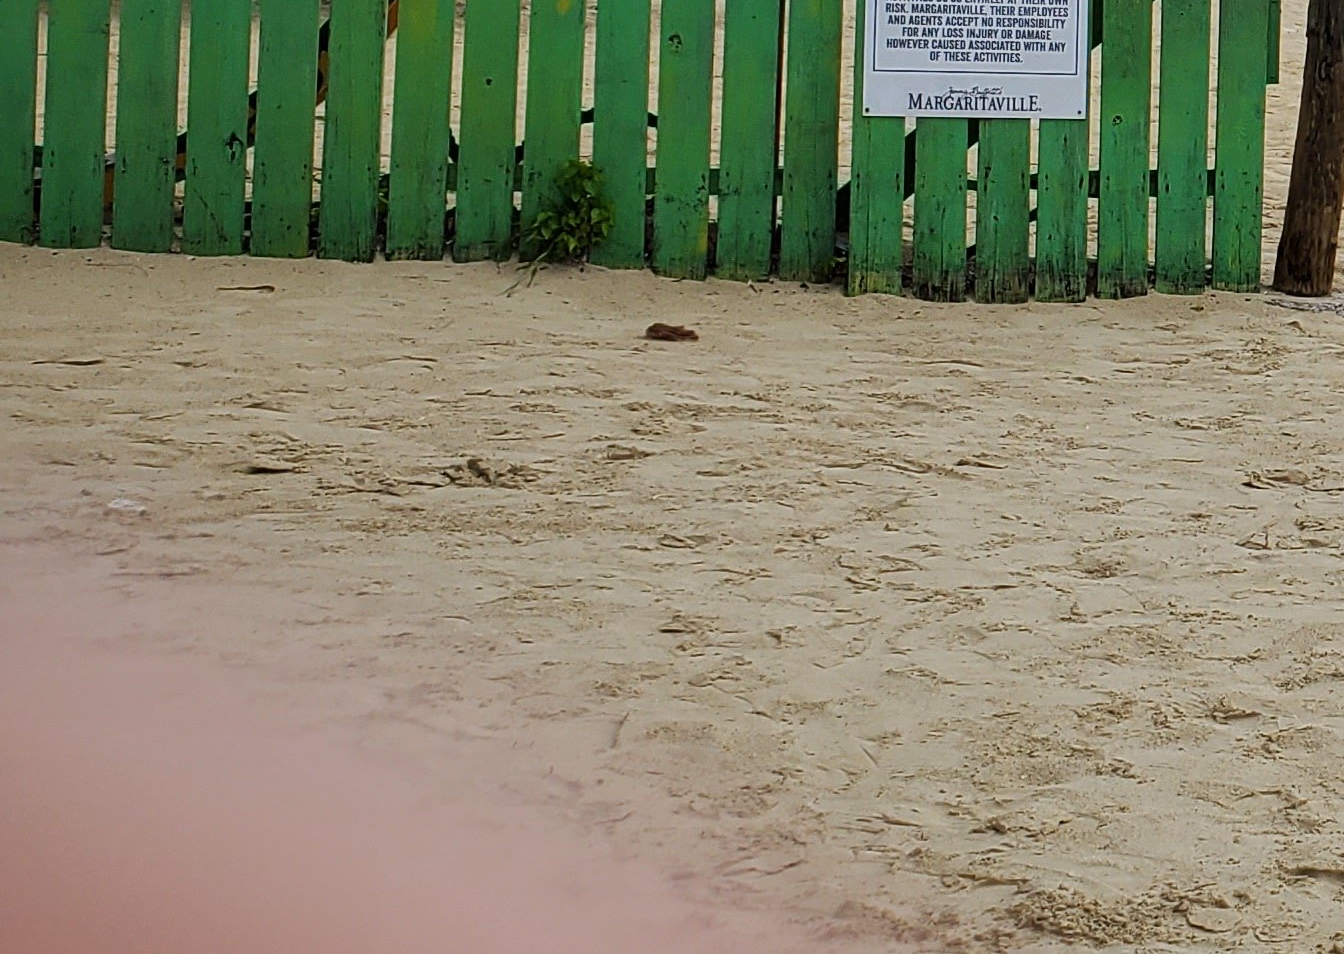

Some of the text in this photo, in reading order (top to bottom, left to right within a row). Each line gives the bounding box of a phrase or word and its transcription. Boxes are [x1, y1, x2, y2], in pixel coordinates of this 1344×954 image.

[886, 3, 908, 13] RISK.
[990, 6, 1015, 16] THEIR
[1018, 7, 1068, 17] EMPLOYEES
[888, 15, 1065, 29] AND AGENTS ACCEPT NO RESPONSIBILITY
[902, 27, 1051, 40] FOR ANY LOSS INJURY OR DAMAGE
[887, 39, 1066, 52] HOWEVER CAUSED ASSOCIATED WITH ANY
[930, 51, 1023, 63] OF THESE ACTIVITIES.
